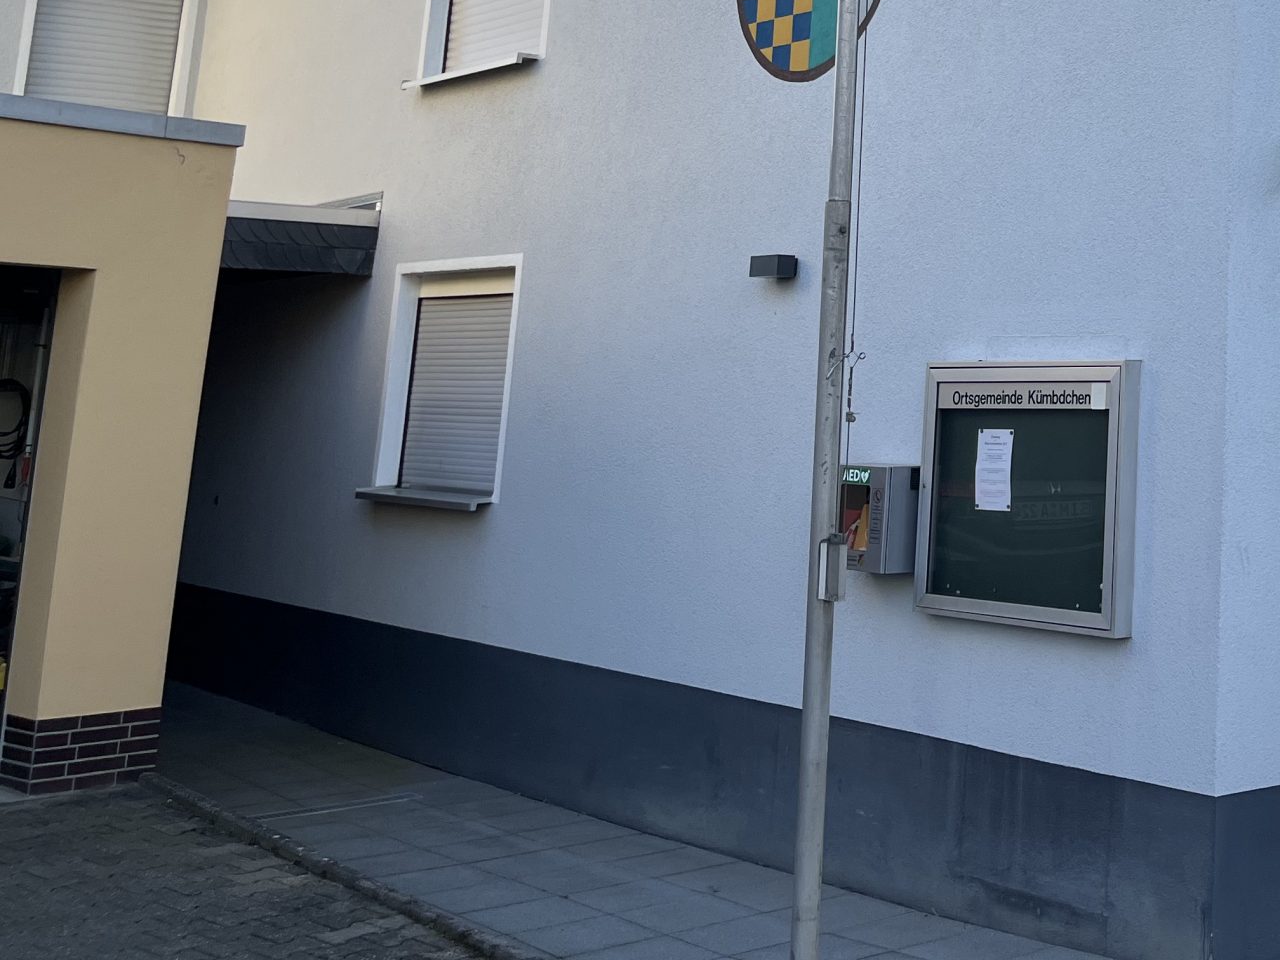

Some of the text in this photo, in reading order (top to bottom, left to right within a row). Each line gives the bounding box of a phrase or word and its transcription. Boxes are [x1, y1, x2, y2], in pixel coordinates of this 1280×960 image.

[952, 389, 1091, 407] Ortsgemeinde Kümbdchen
[843, 468, 860, 482] AED
